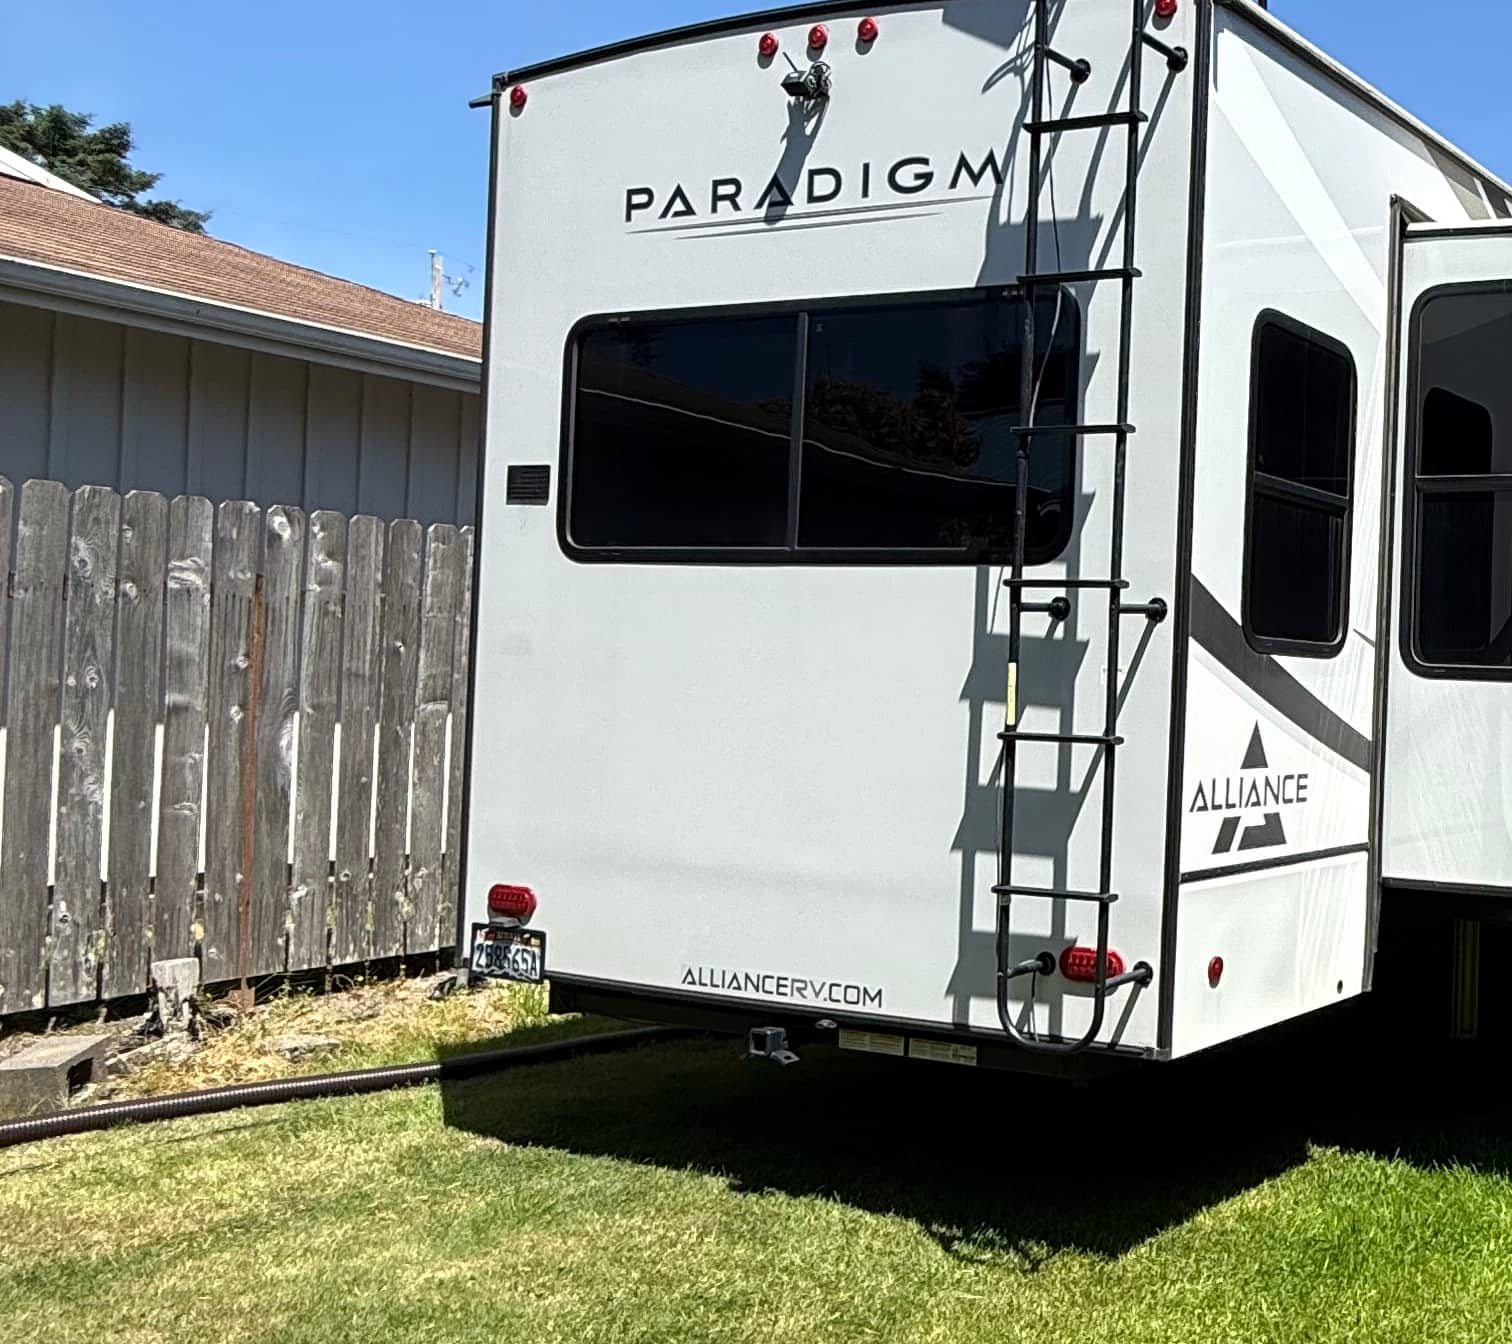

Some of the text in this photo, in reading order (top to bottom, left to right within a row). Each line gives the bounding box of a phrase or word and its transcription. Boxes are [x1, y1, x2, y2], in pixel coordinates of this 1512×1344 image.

[624, 147, 1005, 224] PARADIGM
[1188, 773, 1309, 813] ALLIANCE
[681, 967, 884, 1009] ALLIANCERV.COM
